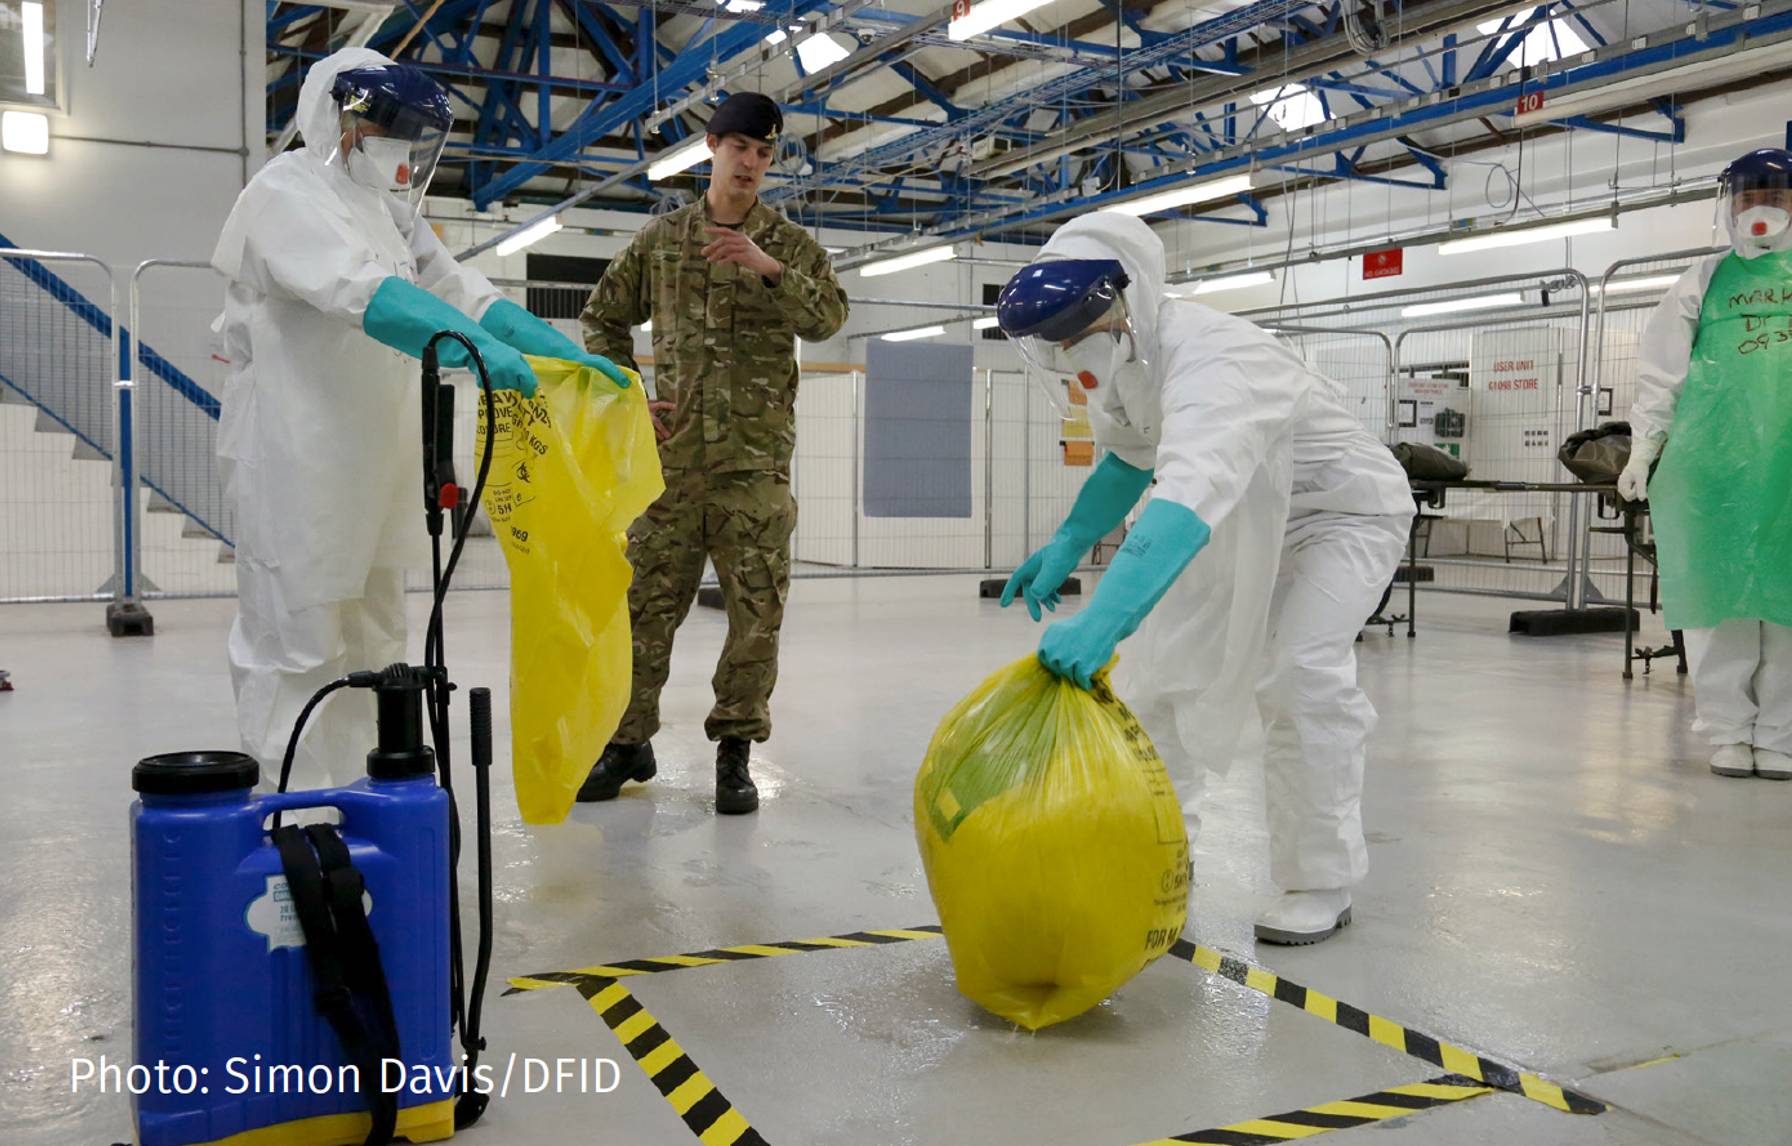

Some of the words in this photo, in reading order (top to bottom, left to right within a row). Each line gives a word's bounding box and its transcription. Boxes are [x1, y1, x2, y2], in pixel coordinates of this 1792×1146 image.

[956, 0, 966, 17] 9
[1521, 94, 1539, 112] 10
[1513, 378, 1538, 390] STORE
[528, 434, 549, 456] KGS
